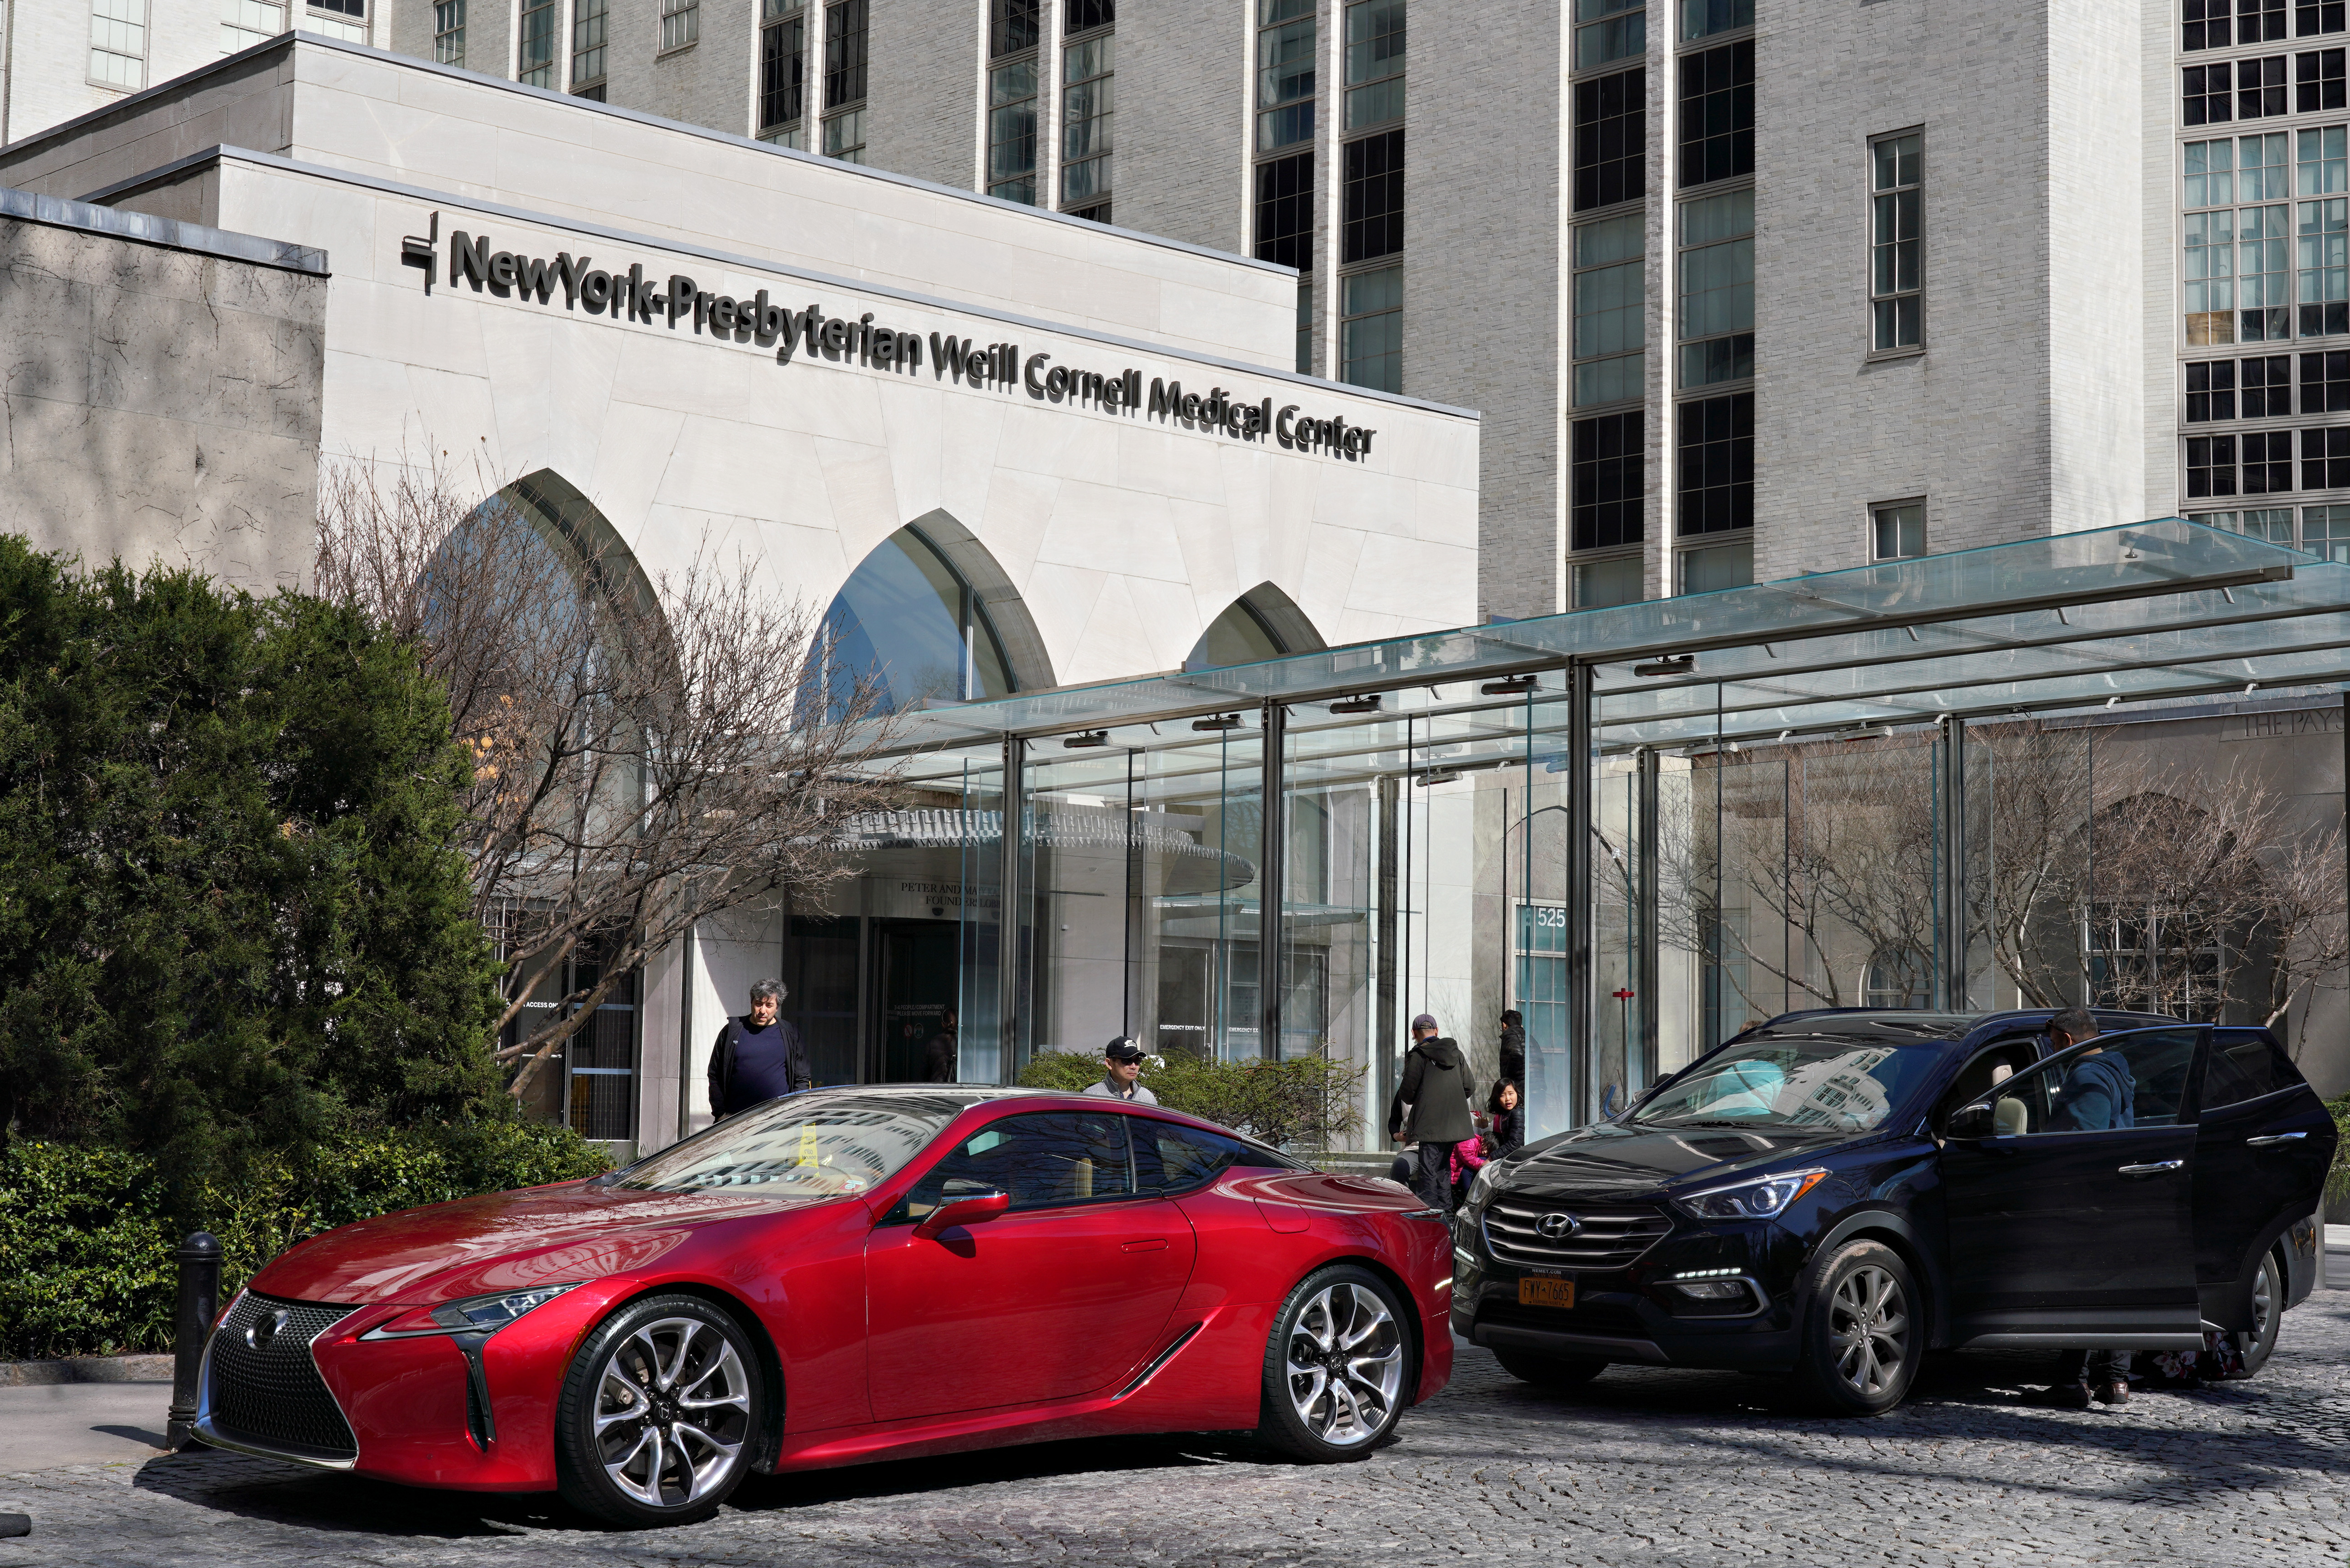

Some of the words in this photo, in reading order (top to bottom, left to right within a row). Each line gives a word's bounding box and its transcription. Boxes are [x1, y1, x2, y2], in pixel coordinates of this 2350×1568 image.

[451, 230, 922, 365] NewYork-Presbyterian
[930, 332, 1018, 385] Weill
[1025, 352, 1141, 408] Cornell
[1150, 377, 1272, 434] Medical
[1276, 404, 1376, 454] Center
[2241, 713, 2283, 737] THE
[901, 882, 937, 893] PETER
[939, 884, 961, 894] AND
[1538, 907, 1566, 927] 525
[1525, 1280, 1541, 1298] FWY
[1547, 1281, 1569, 1301] 7665
